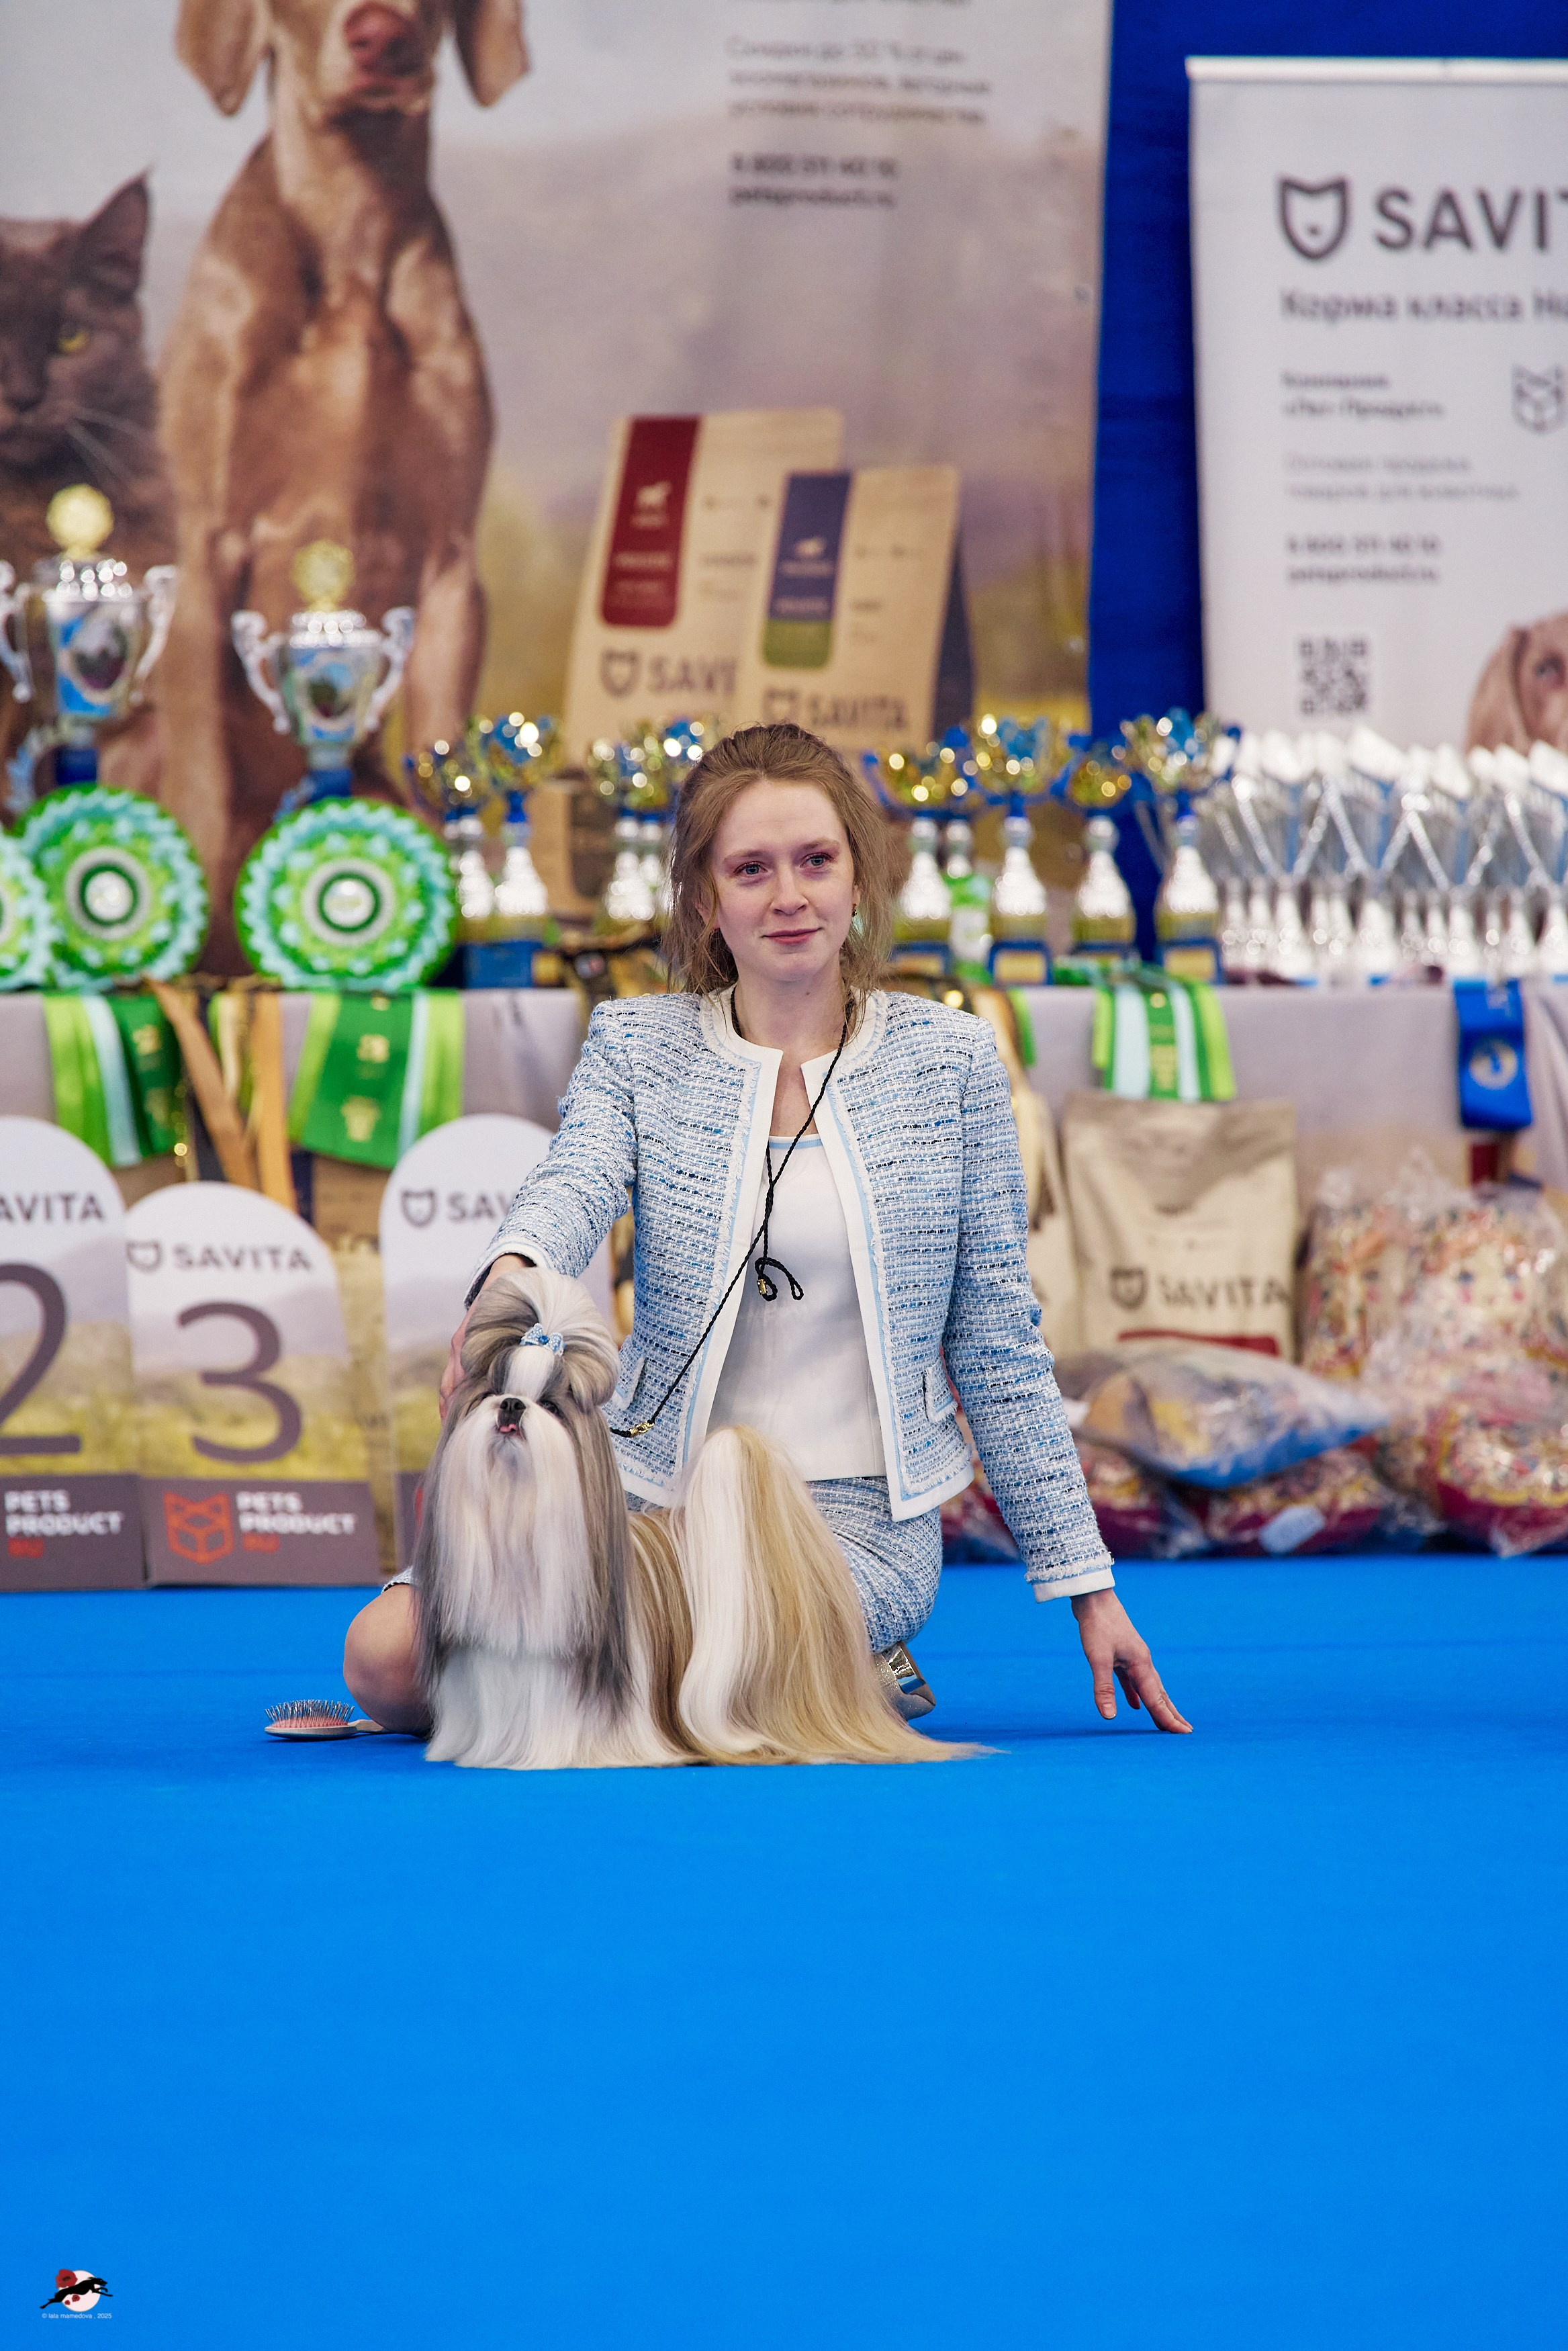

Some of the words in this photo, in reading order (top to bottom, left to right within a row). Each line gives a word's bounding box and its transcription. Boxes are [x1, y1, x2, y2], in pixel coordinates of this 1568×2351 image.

[173, 1244, 312, 1271] SAVITA
[0, 1262, 81, 1456] 2
[177, 1301, 303, 1465] 3
[4, 1489, 70, 1513] PETS
[236, 1491, 302, 1513] PETS
[5, 1511, 124, 1537] PRODUCT
[238, 1513, 358, 1535] PRODUCT
